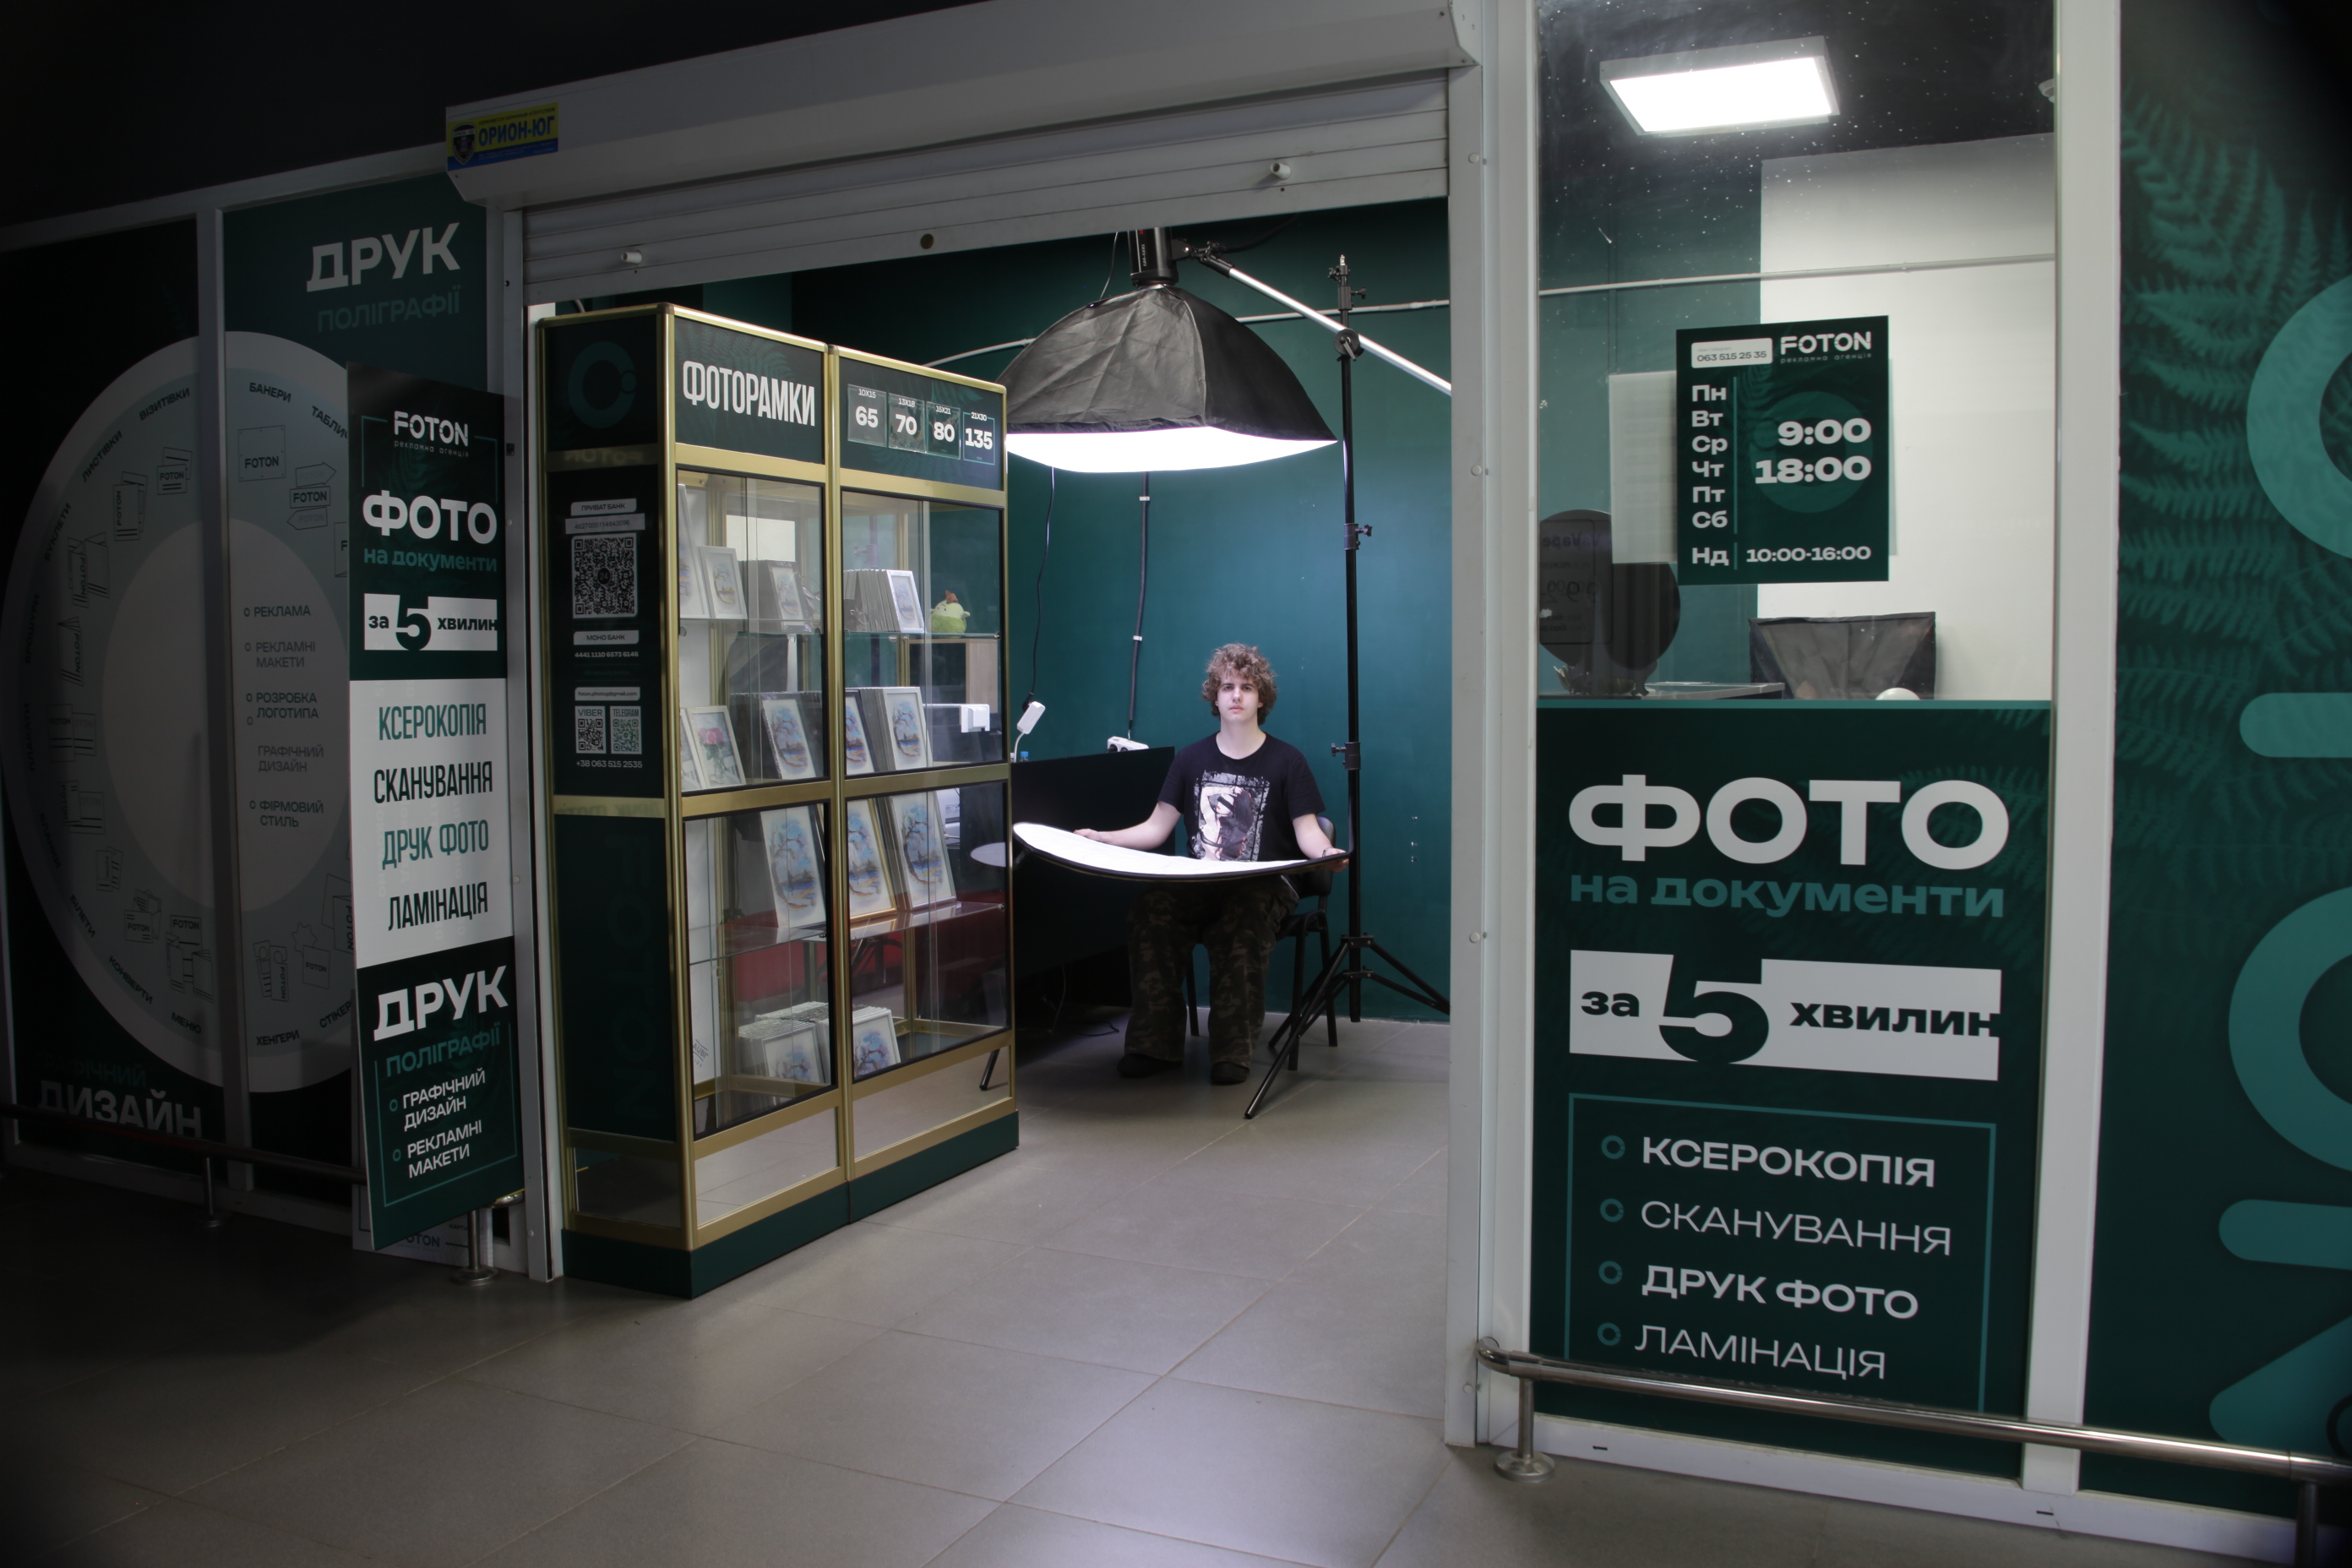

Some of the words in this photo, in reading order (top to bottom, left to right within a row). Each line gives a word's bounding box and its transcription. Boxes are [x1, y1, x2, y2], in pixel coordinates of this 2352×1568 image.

[478, 115, 555, 146] ОРИОН-ЮГ
[306, 222, 461, 292] ДРУК
[318, 285, 460, 332] ПОЛІГРАФІЇ
[1780, 331, 1871, 355] FOTON
[1696, 353, 1717, 362] 063
[1719, 352, 1737, 361] 515
[1739, 351, 1751, 360] 25
[1780, 356, 1828, 365] рекламна
[1834, 352, 1872, 361] агенція
[249, 382, 291, 403] БАНЕРИ
[682, 360, 815, 427] ФОТОРАМКИ
[1691, 384, 1727, 402] Пн
[139, 388, 190, 421] ВІЗИТІВКИ
[855, 406, 879, 428] 65
[895, 413, 917, 436] 70
[1691, 410, 1723, 427] Вт
[394, 411, 468, 447] FOTON
[934, 422, 955, 443] 80
[965, 427, 993, 450] 135
[1777, 417, 1872, 446] 9:00
[82, 430, 122, 482] ЛИСТІВКИ
[394, 440, 434, 453] рекламна
[439, 448, 469, 458] агенція
[1691, 435, 1729, 455] Ср
[244, 456, 280, 469] FOTON
[1691, 460, 1724, 477] Чт
[1755, 455, 1872, 484] 18:00
[159, 471, 184, 481] FOTON
[293, 491, 327, 504] FOTON
[1692, 486, 1725, 504] Пт
[298, 513, 324, 524] FOTON
[362, 489, 498, 545] ФОТО
[1691, 510, 1729, 529] Сб
[45, 503, 71, 562] БУКЛЕТИ
[363, 548, 389, 564] на
[391, 552, 498, 572] документи
[1691, 547, 1729, 567] Нд
[1745, 546, 1872, 563] 10:00-16:00
[253, 605, 311, 618] РЕКЛАМА
[368, 615, 389, 629] за
[395, 594, 432, 651] 5
[438, 617, 498, 631] хвилин
[255, 641, 316, 653] РЕКЛАМНІ
[256, 656, 305, 668] МАКЕТИ
[256, 692, 318, 704] РОЗРОБКА
[256, 707, 319, 719] ЛОГОТИПА
[379, 703, 487, 741] КСЕРОКОПІЯ
[612, 709, 639, 717] TELEGRAM
[258, 743, 324, 758] ГРАФІЧНИЙ
[258, 759, 308, 773] ДИЗАЙН
[374, 761, 493, 803] СКАНУВАННЯ
[259, 799, 324, 814] ФІРМОВИЙ
[259, 814, 299, 828] СТИЛЬ
[1568, 774, 2010, 870] ФОТО
[382, 825, 433, 870] ДРУК
[439, 819, 488, 856] ФОТО
[388, 881, 488, 931] ЛАМІНАЦІЯ
[1571, 874, 1638, 905] на
[1650, 876, 2005, 918] документи
[70, 895, 95, 938] БІЛЕТИ
[128, 923, 150, 932] FOTON
[172, 918, 199, 930] FOTON
[306, 961, 327, 972] FOTON
[604, 834, 661, 1121] FOTON
[108, 956, 153, 1004] КОНВЕРТИ
[373, 965, 509, 1042] ДРУК
[1581, 990, 1640, 1018] за
[1658, 955, 1769, 1064] 5
[1788, 1002, 2001, 1037] хвилин
[172, 1012, 201, 1034] МЕНЮ
[256, 1029, 300, 1046] ХЕНГЕРИ
[385, 1021, 501, 1077] ПОЛІГРАФІЇ
[402, 1067, 486, 1109] ГРАФІЧНИЙ
[37, 1080, 202, 1138] ДИЗАЙН
[404, 1095, 467, 1132] ДИЗАЙН
[406, 1119, 482, 1159] РЕКЛАМНІ
[408, 1143, 471, 1179] МАКЕТИ
[1642, 1136, 1936, 1188] КСЕРОКОПІЯ
[1641, 1200, 1952, 1256] СКАНУВАННЯ
[406, 1233, 440, 1248] OTON
[1642, 1264, 1767, 1304] ДРУК
[1775, 1279, 1919, 1320] ФОТО
[1634, 1324, 1886, 1380] ЛАМІНАЦІЯ
